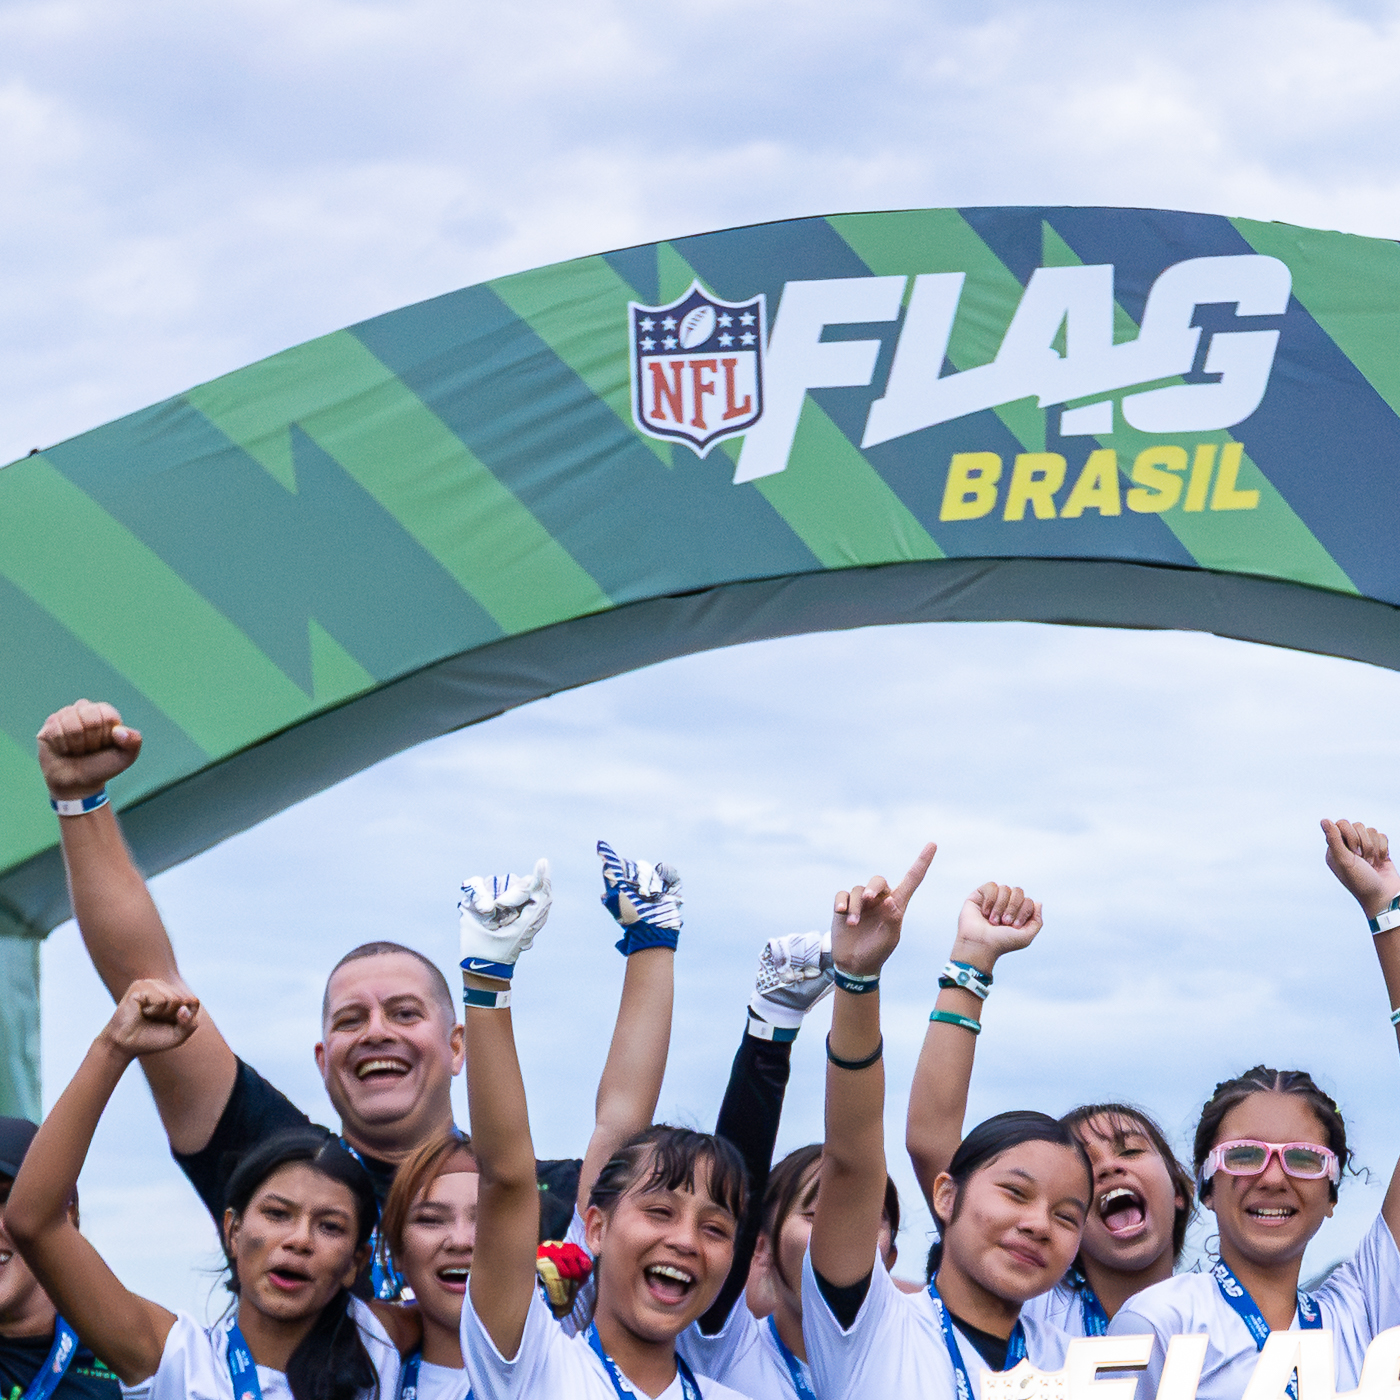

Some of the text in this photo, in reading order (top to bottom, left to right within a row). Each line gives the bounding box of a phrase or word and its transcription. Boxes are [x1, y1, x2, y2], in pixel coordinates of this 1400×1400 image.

[649, 254, 1292, 484] NFL FLAG
[939, 443, 1260, 521] BRASIL
